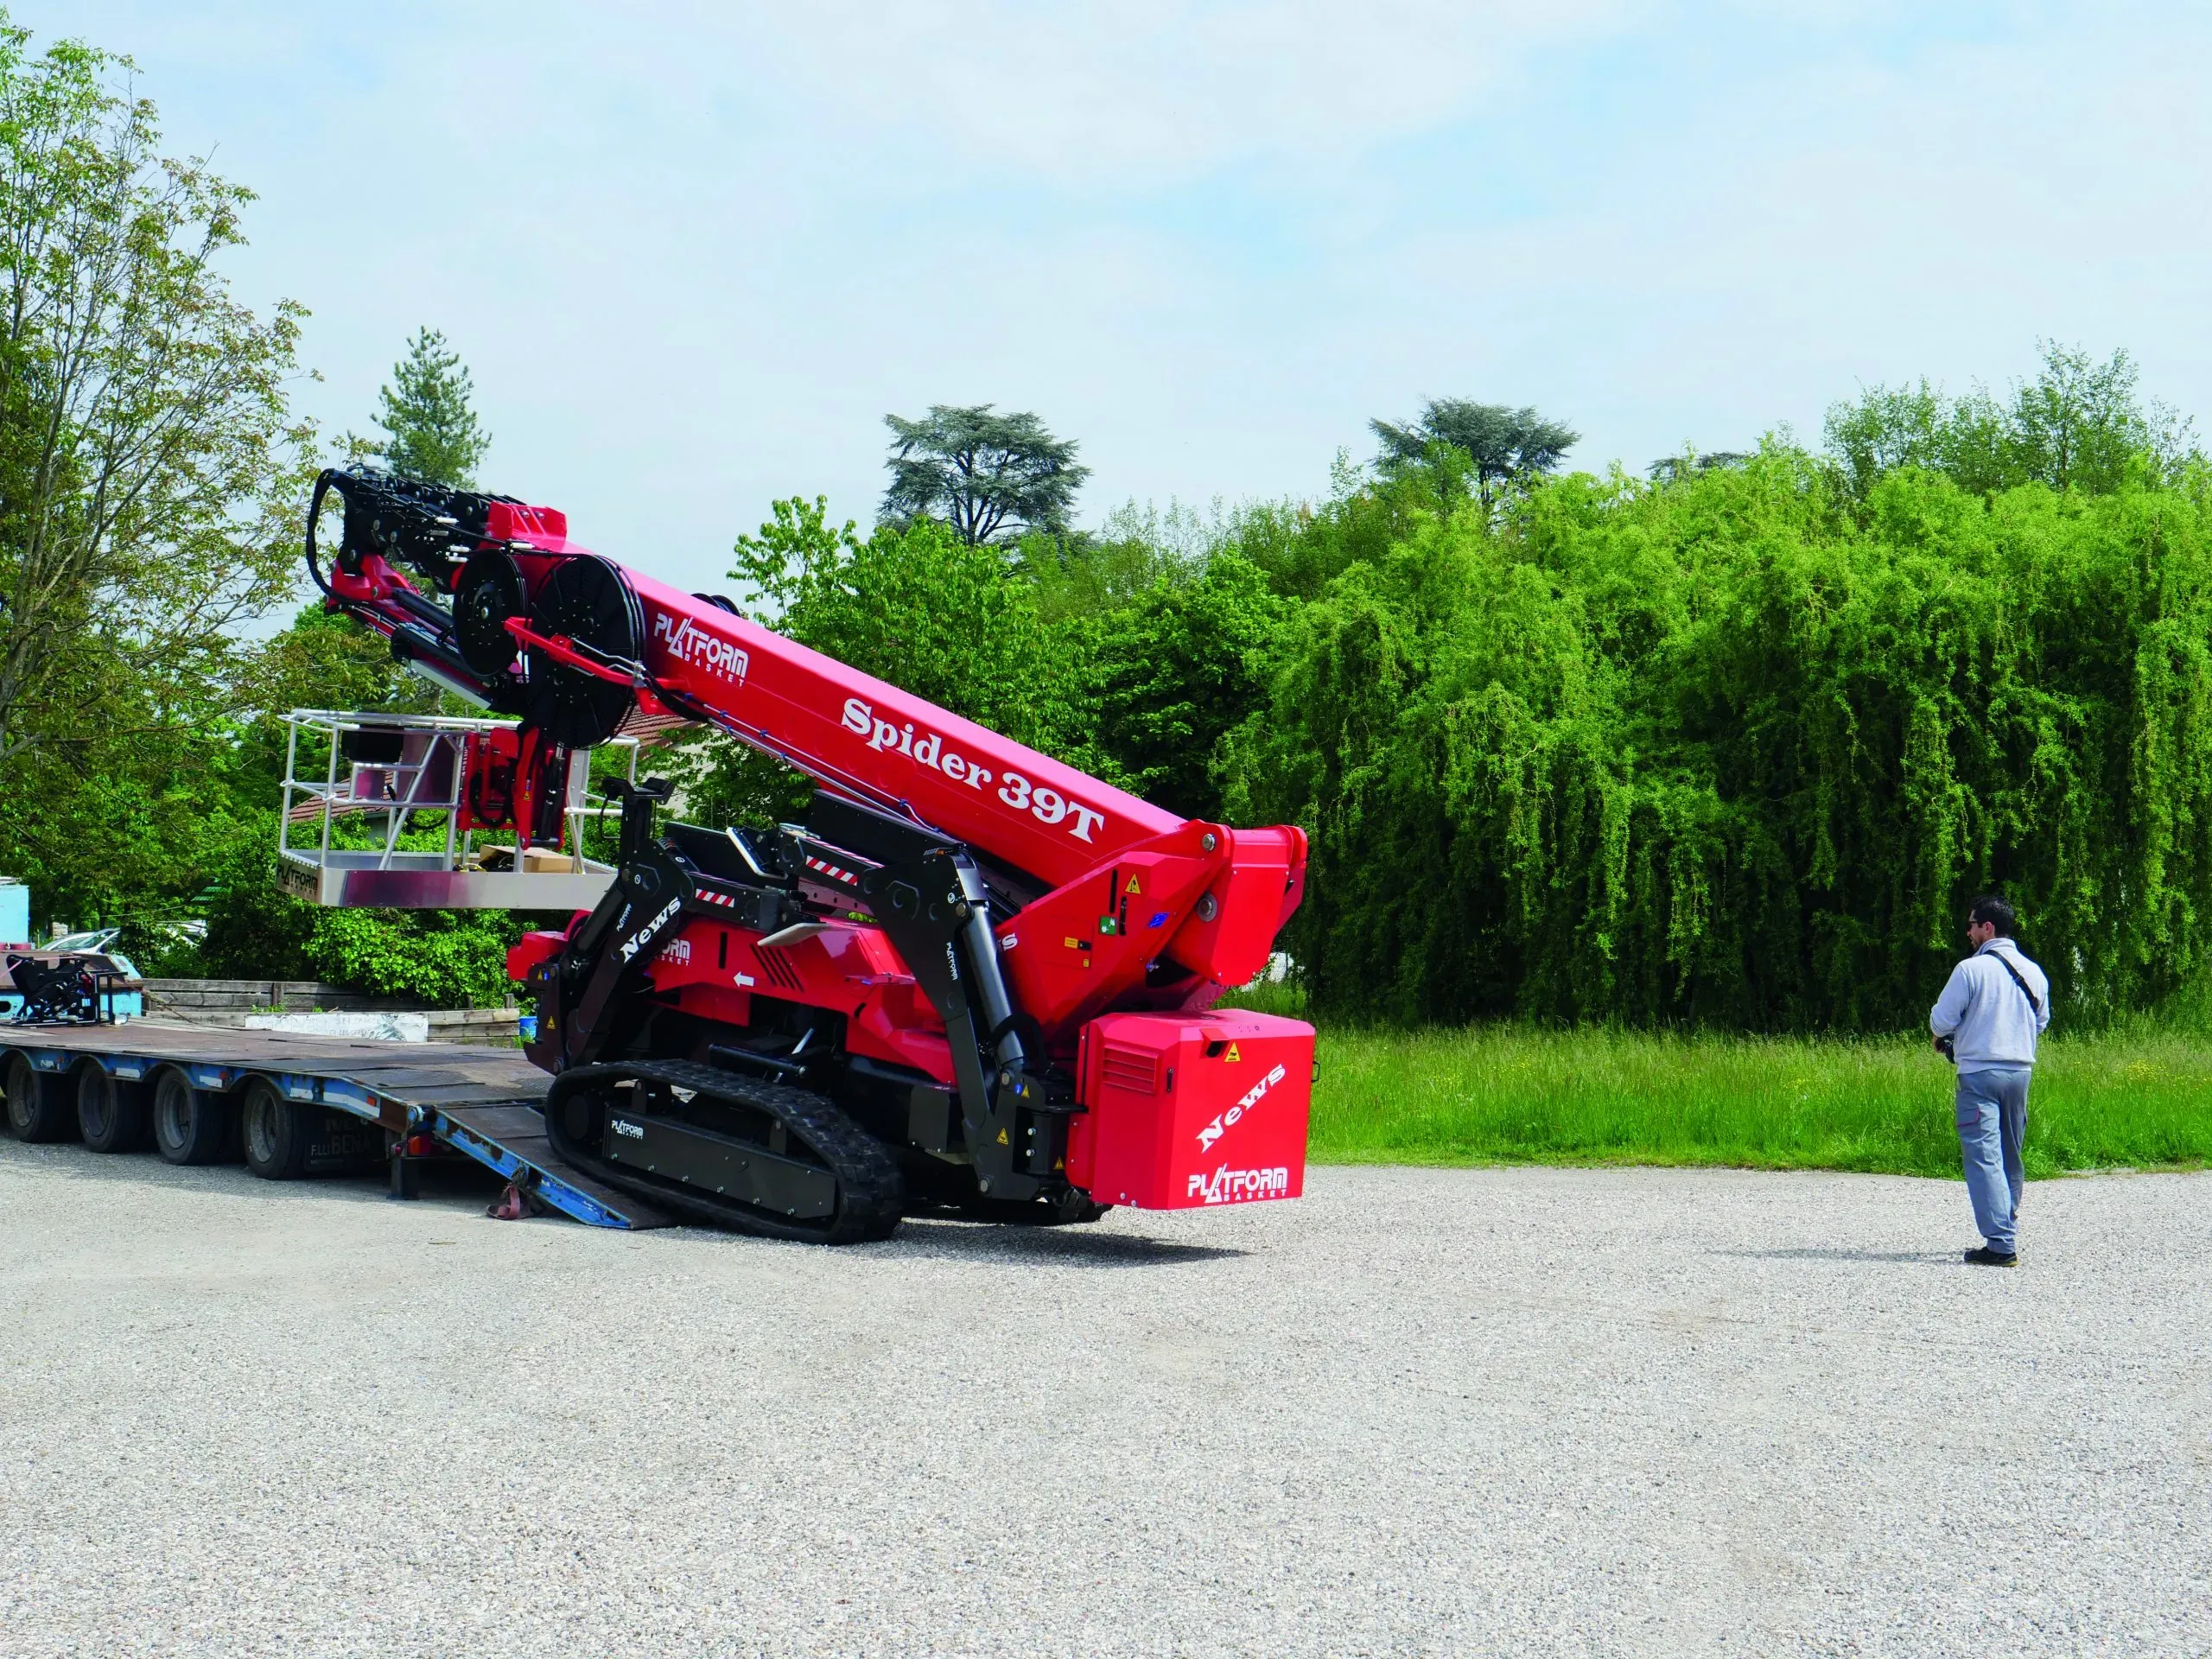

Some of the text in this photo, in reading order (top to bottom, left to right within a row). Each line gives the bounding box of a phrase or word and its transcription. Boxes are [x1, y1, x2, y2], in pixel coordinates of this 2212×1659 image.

[654, 613, 749, 678] PLATFORM
[683, 652, 745, 688] BASKET
[840, 697, 1105, 844] Spider 39T
[619, 896, 681, 964] News
[611, 1120, 644, 1137] PLATFORM
[1195, 1063, 1286, 1154] News
[1187, 1162, 1288, 1204] PLATFORM
[1224, 1189, 1287, 1202] BASKET
